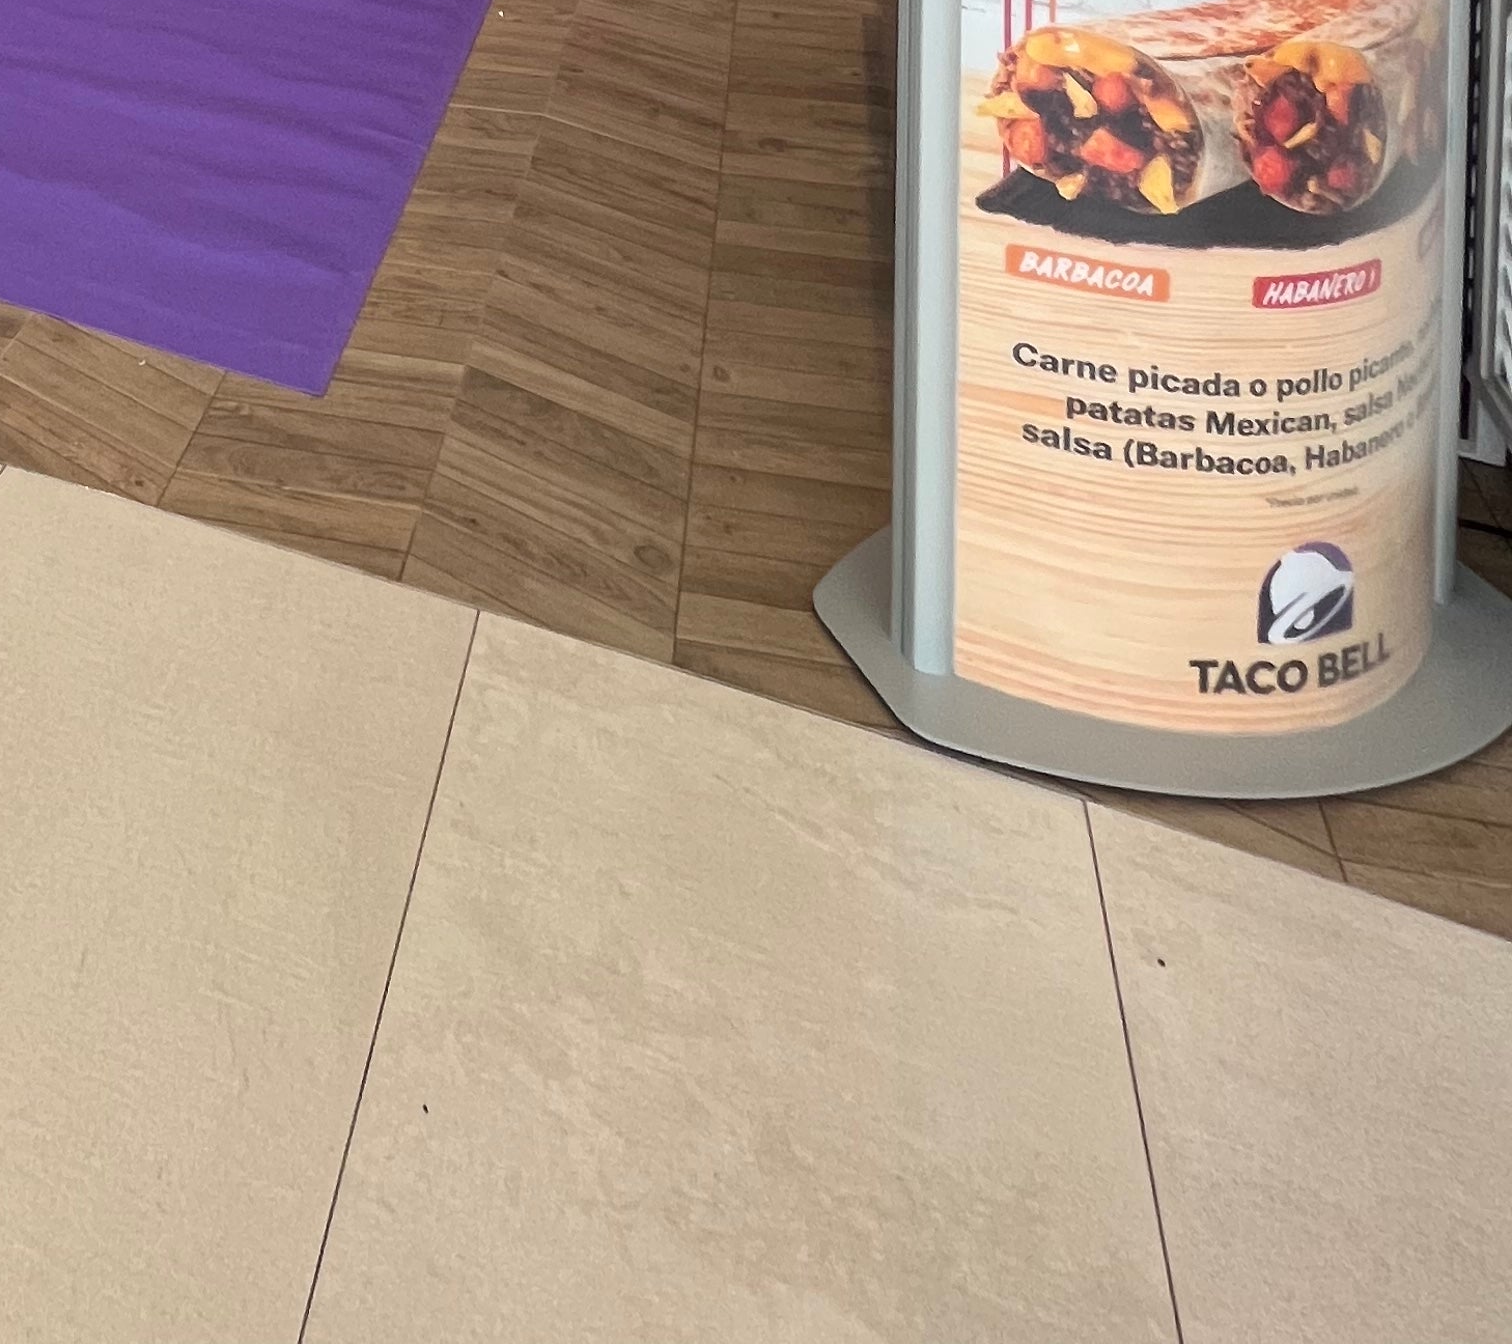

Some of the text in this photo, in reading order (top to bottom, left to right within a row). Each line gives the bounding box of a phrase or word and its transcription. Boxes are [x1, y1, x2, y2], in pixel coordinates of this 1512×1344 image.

[1019, 251, 1154, 296] BARBACOA
[1262, 270, 1364, 305] HABANERO
[1012, 341, 1118, 384] Carne
[1128, 366, 1240, 396] picada
[1249, 377, 1267, 397] o
[1276, 368, 1343, 402] pollo
[1065, 395, 1195, 431] patatas
[1205, 410, 1337, 436] Mexican,
[1343, 391, 1393, 426] salsa
[1022, 422, 1112, 461] salsa
[1123, 437, 1297, 476] (Barbacoa,
[1189, 633, 1391, 695] TACO BELL
